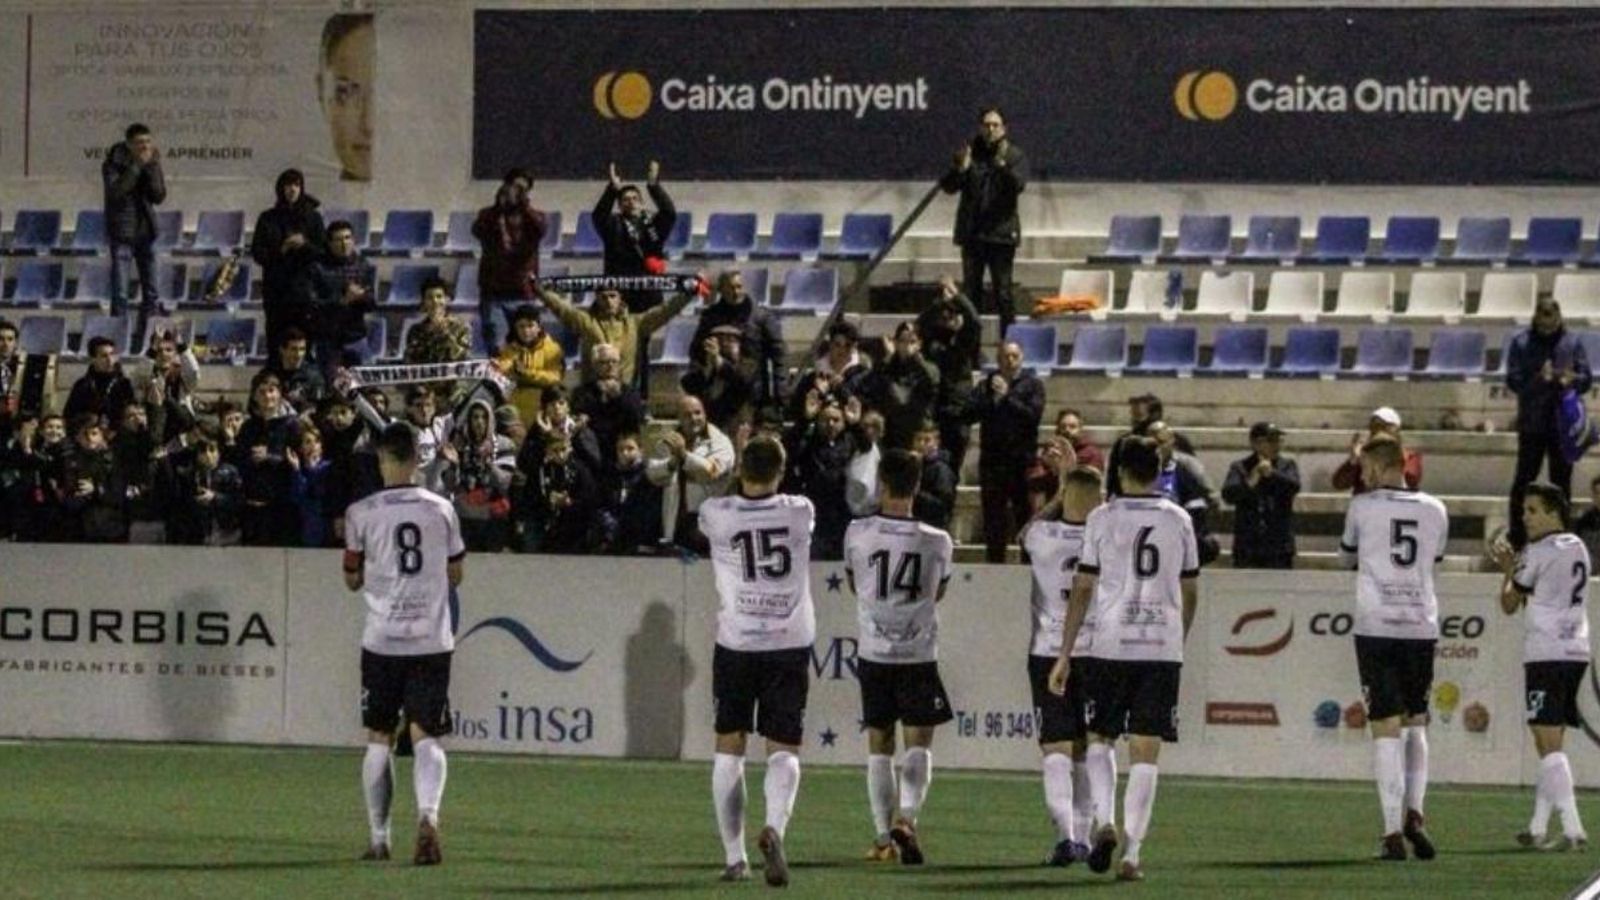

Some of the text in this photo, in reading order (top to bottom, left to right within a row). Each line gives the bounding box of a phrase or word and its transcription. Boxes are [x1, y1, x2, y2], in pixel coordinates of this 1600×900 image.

[660, 75, 929, 119] Caixa Ontinyent
[1245, 75, 1531, 122] Caixa Ontinyent
[166, 147, 254, 160] APRENDER
[556, 275, 677, 291] SUPPORTERS
[396, 521, 424, 575] 8
[730, 526, 792, 583] 15
[1134, 525, 1160, 580] 6
[1390, 518, 1418, 567] 5
[868, 549, 922, 602] 14
[1570, 560, 1588, 606] 2
[0, 607, 276, 648] CORBISA
[0, 659, 276, 679] FABRICANTES DE BIESES
[499, 690, 594, 744] insa
[956, 710, 1033, 740] Tel 96 348
